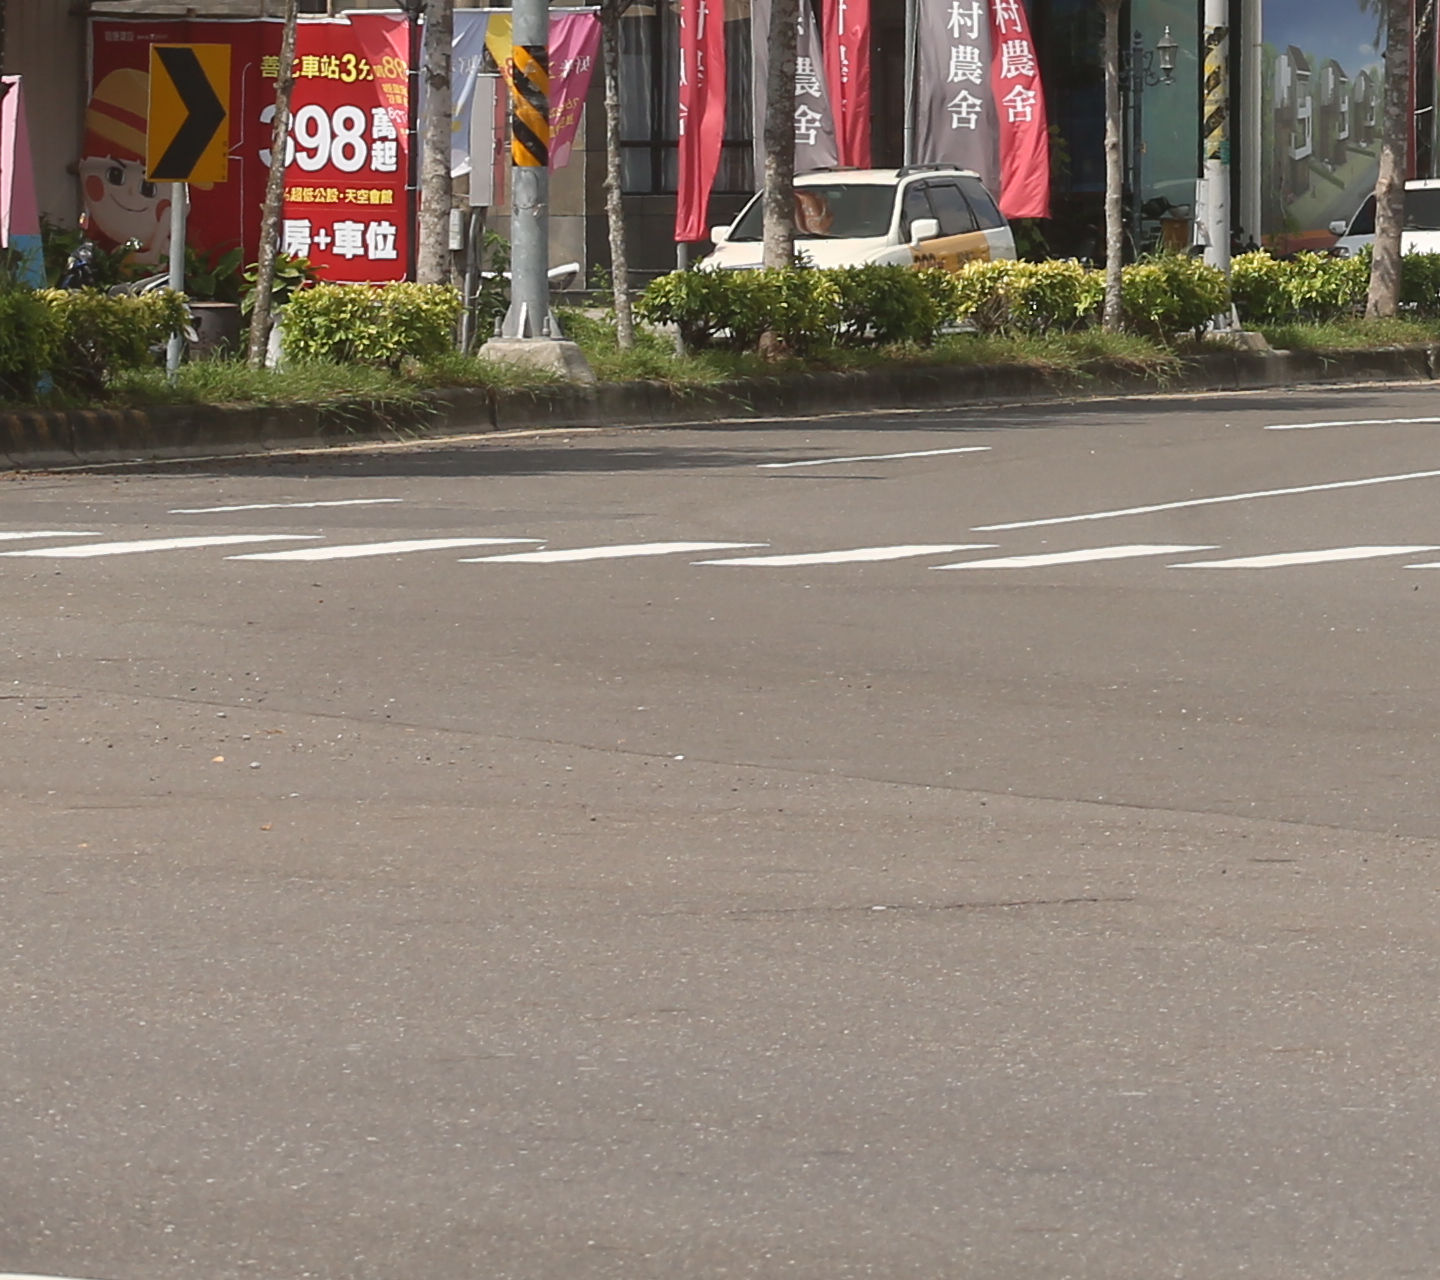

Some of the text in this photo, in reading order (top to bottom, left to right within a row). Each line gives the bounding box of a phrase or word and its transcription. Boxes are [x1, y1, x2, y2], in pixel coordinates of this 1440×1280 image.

[261, 54, 373, 83] 善車站3分
[276, 219, 398, 260] 房+車位
